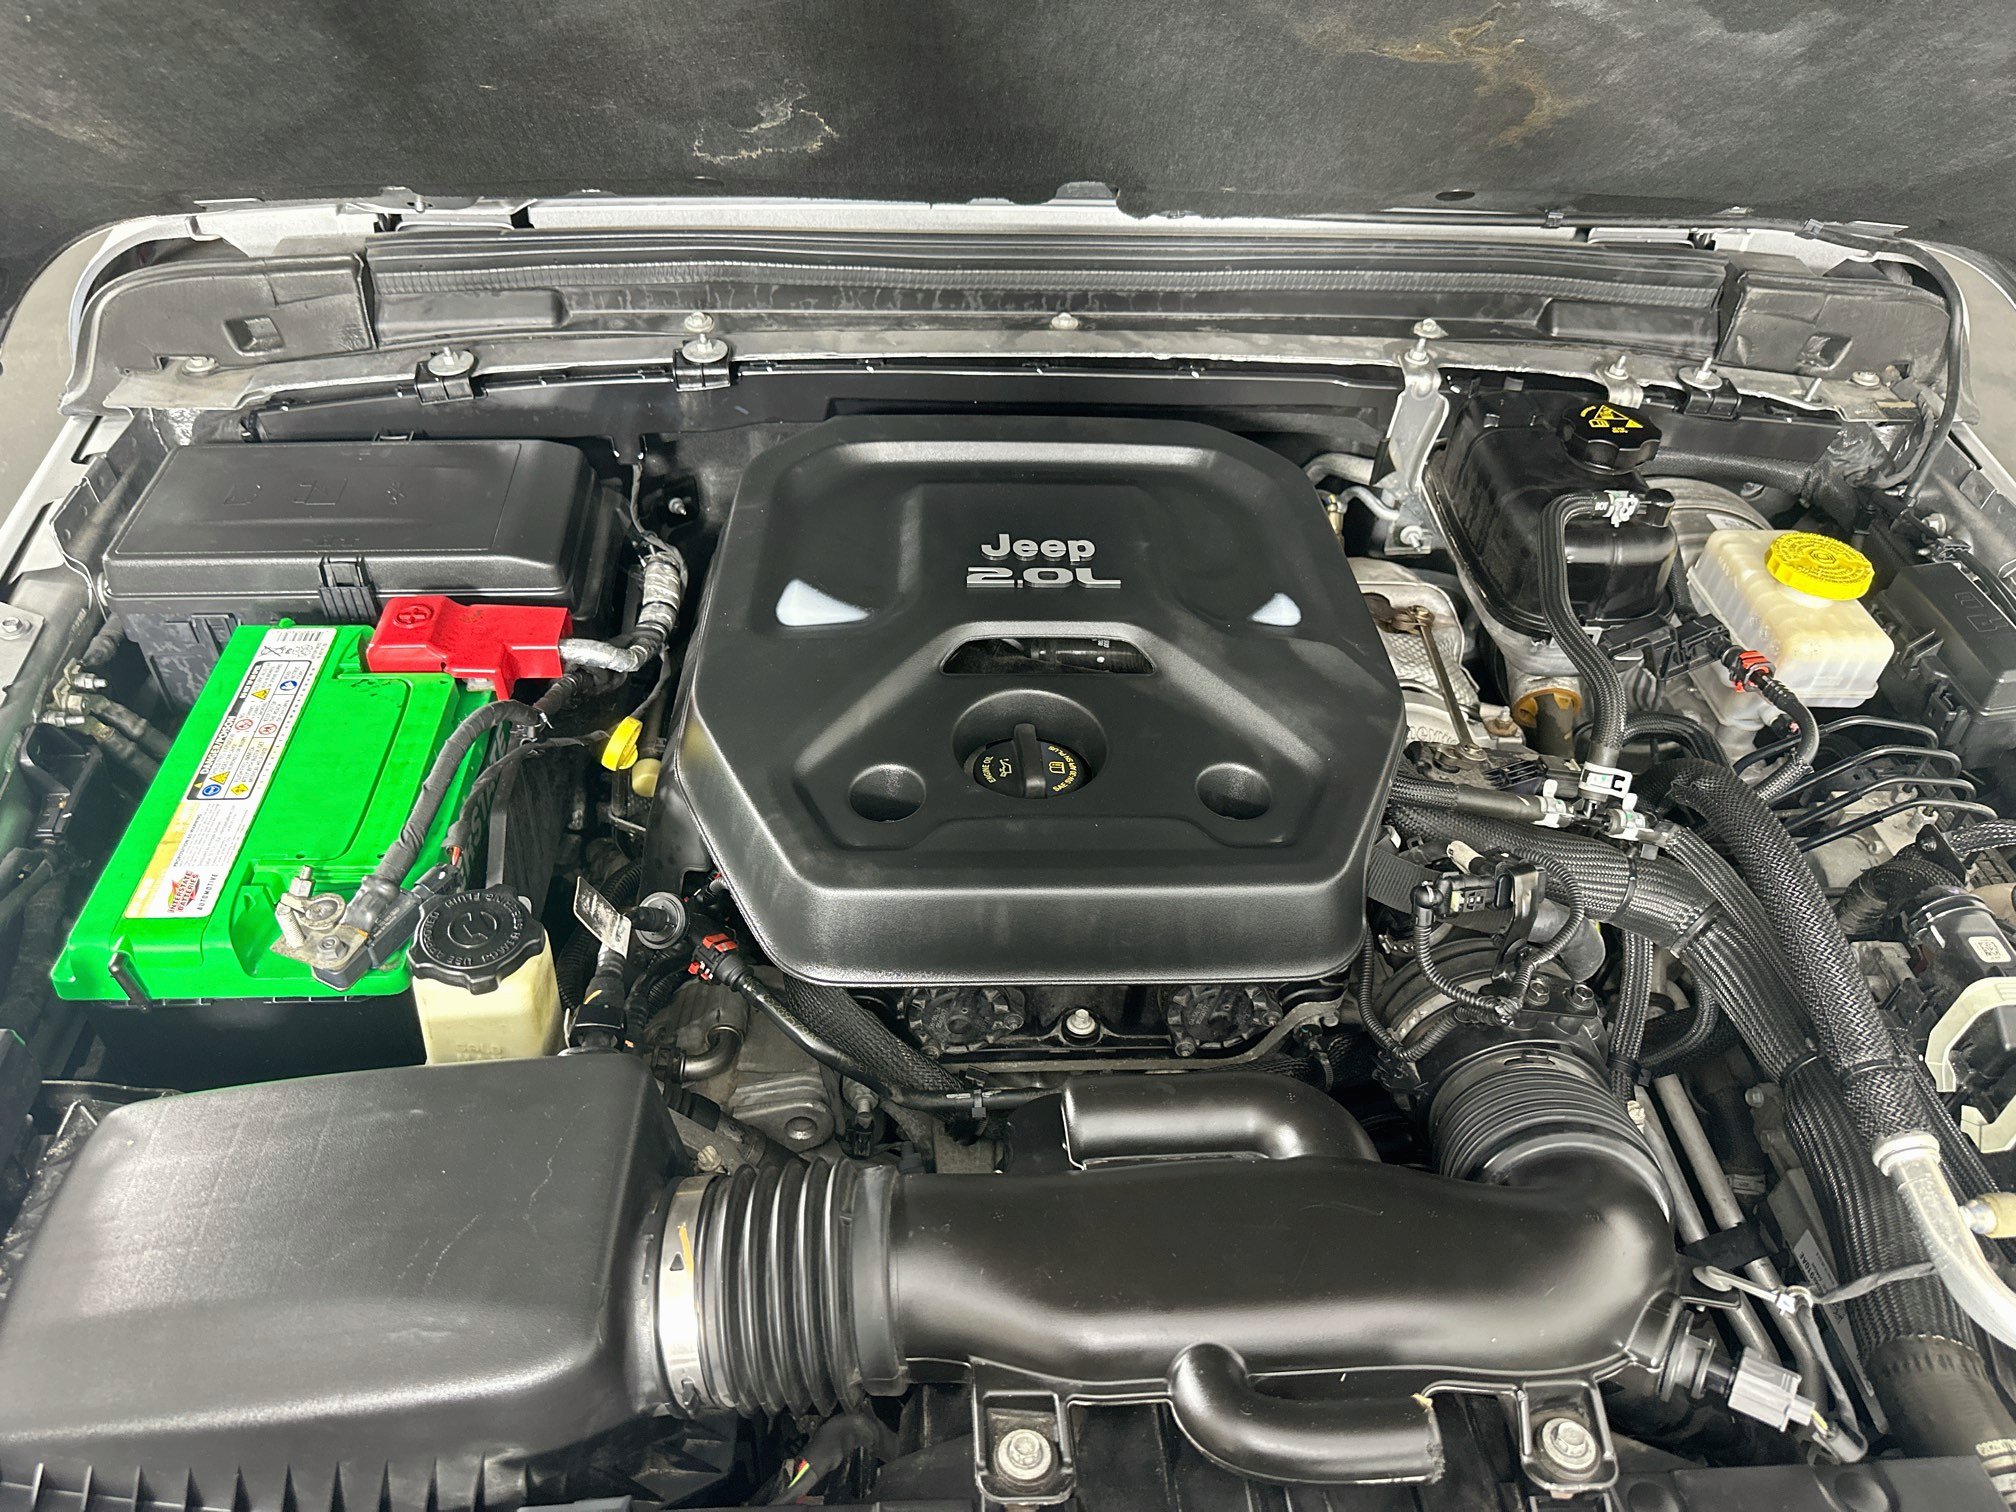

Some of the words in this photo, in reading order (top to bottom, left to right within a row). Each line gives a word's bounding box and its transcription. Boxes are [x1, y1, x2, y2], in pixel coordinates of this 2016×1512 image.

[981, 534, 1096, 565] Jeep
[966, 567, 1122, 589] 2.0L
[983, 756, 994, 764] OIL
[981, 764, 997, 784] ENGINE
[197, 873, 218, 910] AUTOMOTIVE
[446, 955, 472, 966] USE
